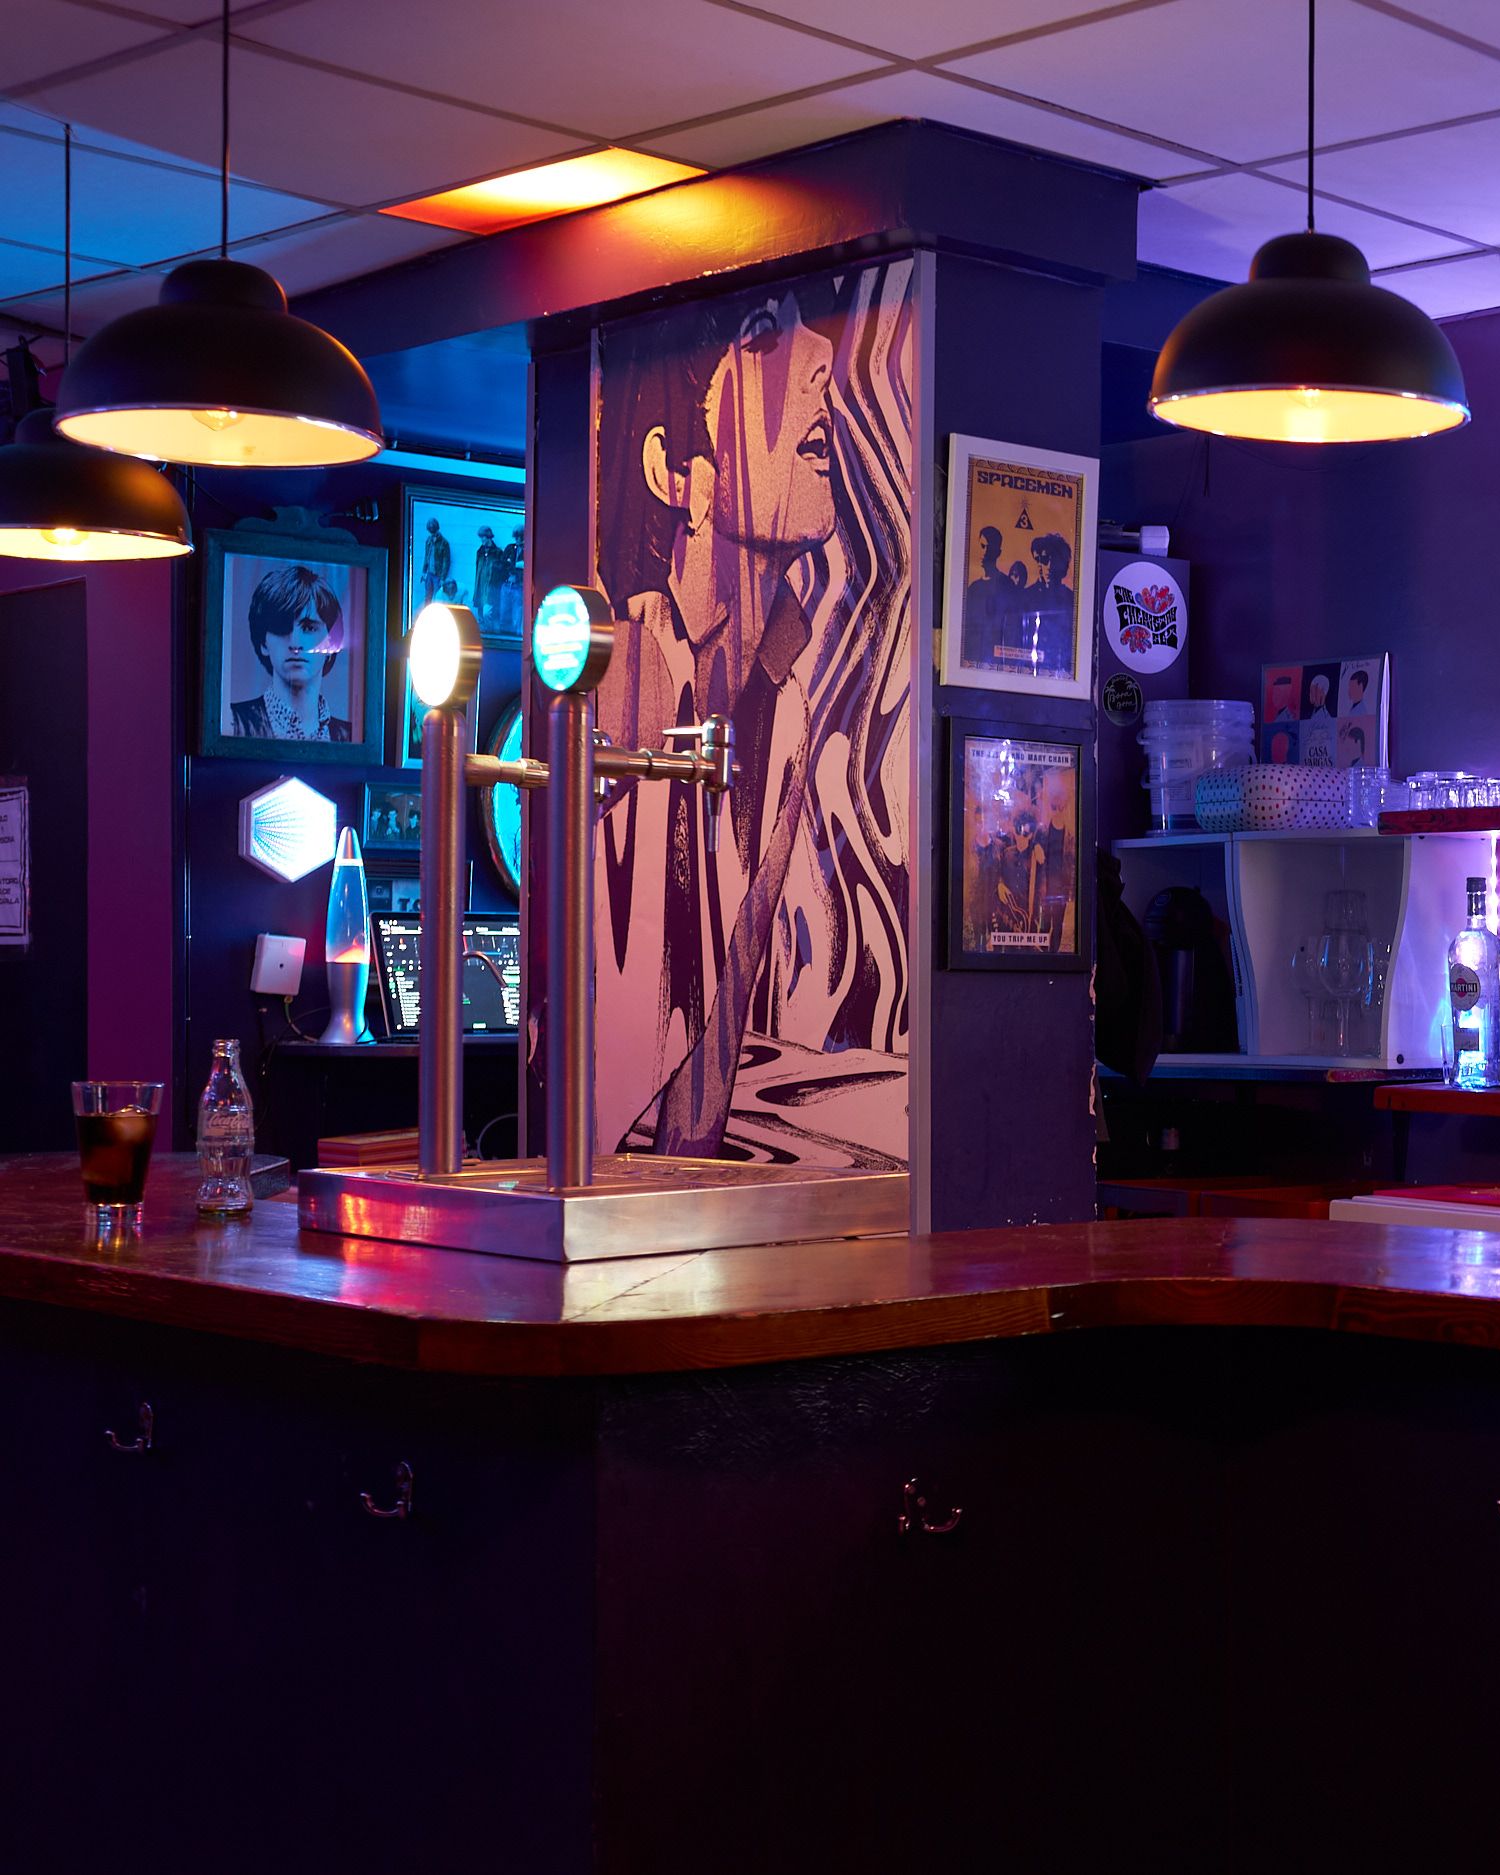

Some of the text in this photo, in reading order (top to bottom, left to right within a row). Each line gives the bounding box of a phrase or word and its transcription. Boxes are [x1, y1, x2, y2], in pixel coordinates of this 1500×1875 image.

[976, 470, 1073, 499] SPACEMEN
[1309, 746, 1328, 757] CASA
[1028, 753, 1046, 762] MARY
[1048, 755, 1069, 764] CHAIN
[992, 934, 1048, 944] YOU TRIP ME UP
